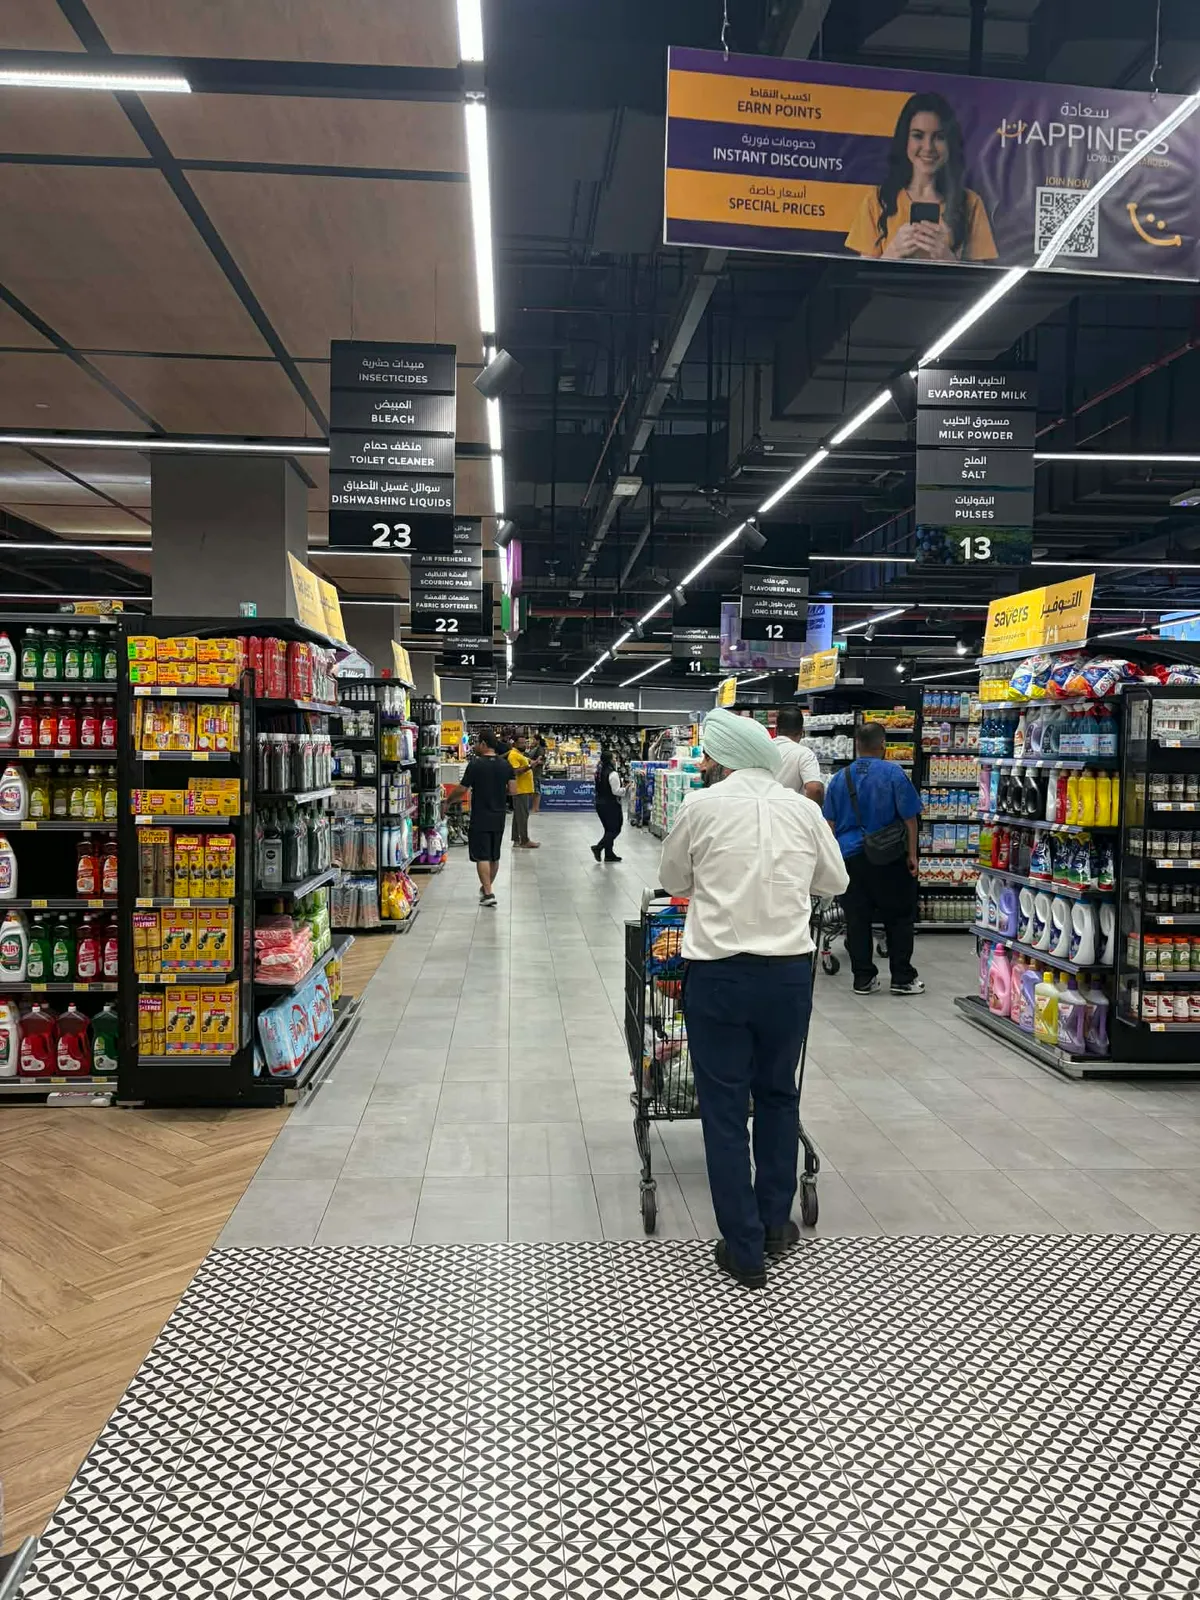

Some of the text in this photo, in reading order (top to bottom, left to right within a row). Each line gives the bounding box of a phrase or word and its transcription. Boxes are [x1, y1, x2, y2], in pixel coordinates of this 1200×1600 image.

[750, 87, 778, 99] النقاط
[737, 100, 822, 119] EARN POINTS
[1060, 102, 1109, 119] سعادة
[741, 132, 816, 150] خصومات فورية
[713, 147, 843, 171] INSTANT DISCOUNTS
[1045, 176, 1091, 188] JOIN NOW
[749, 184, 807, 199] أسعار خاصة
[729, 197, 826, 217] SPECIAL PRICES
[361, 358, 425, 371] مبيدات حشرية
[358, 373, 428, 384] INSECTICIDES
[949, 375, 1006, 387] الحليب المبخر
[928, 389, 1027, 400] EVAPORATED MILK
[374, 399, 412, 411] المبيض
[371, 414, 415, 424] BLEACH
[942, 416, 1010, 428] مسحوق الحليب
[938, 430, 1014, 440] MILK POWDER
[363, 440, 422, 453] منظف حمام
[349, 455, 435, 467] TOILET CLEANER
[963, 455, 987, 468] الملح
[961, 470, 987, 479] SALT
[343, 480, 441, 495] سوائل غسيل الأطباق
[331, 494, 452, 508] DISHWASHING LIQUIDS
[954, 495, 995, 507] البقوليات
[955, 510, 994, 519] PULSES
[372, 522, 412, 548] 23
[959, 536, 991, 560] 13
[749, 585, 785, 593] FLAVOURED
[1039, 589, 1083, 620] التوفير
[993, 605, 1029, 628] savers
[435, 618, 459, 633] 22
[765, 624, 784, 639] 12
[460, 654, 475, 665] 21
[688, 661, 701, 672] 11
[584, 698, 635, 710] Homeware
